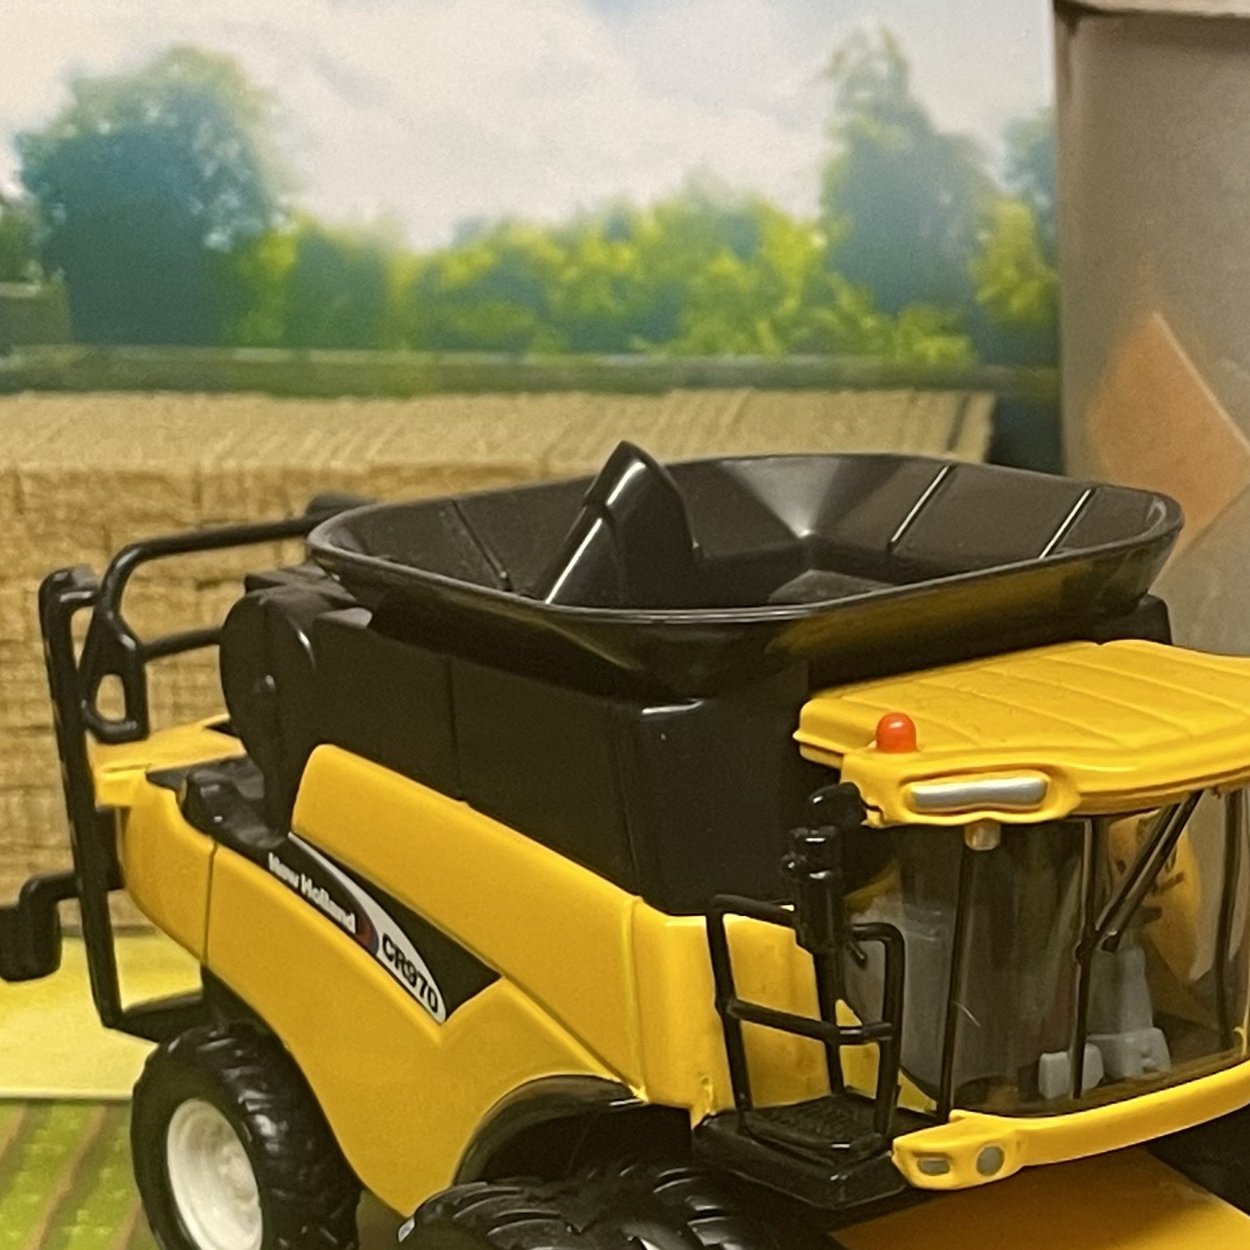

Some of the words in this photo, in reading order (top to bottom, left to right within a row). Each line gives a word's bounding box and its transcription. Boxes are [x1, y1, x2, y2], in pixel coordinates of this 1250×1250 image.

[268, 851, 300, 889] New
[301, 873, 356, 935] Holland
[382, 932, 438, 1014] CR970
